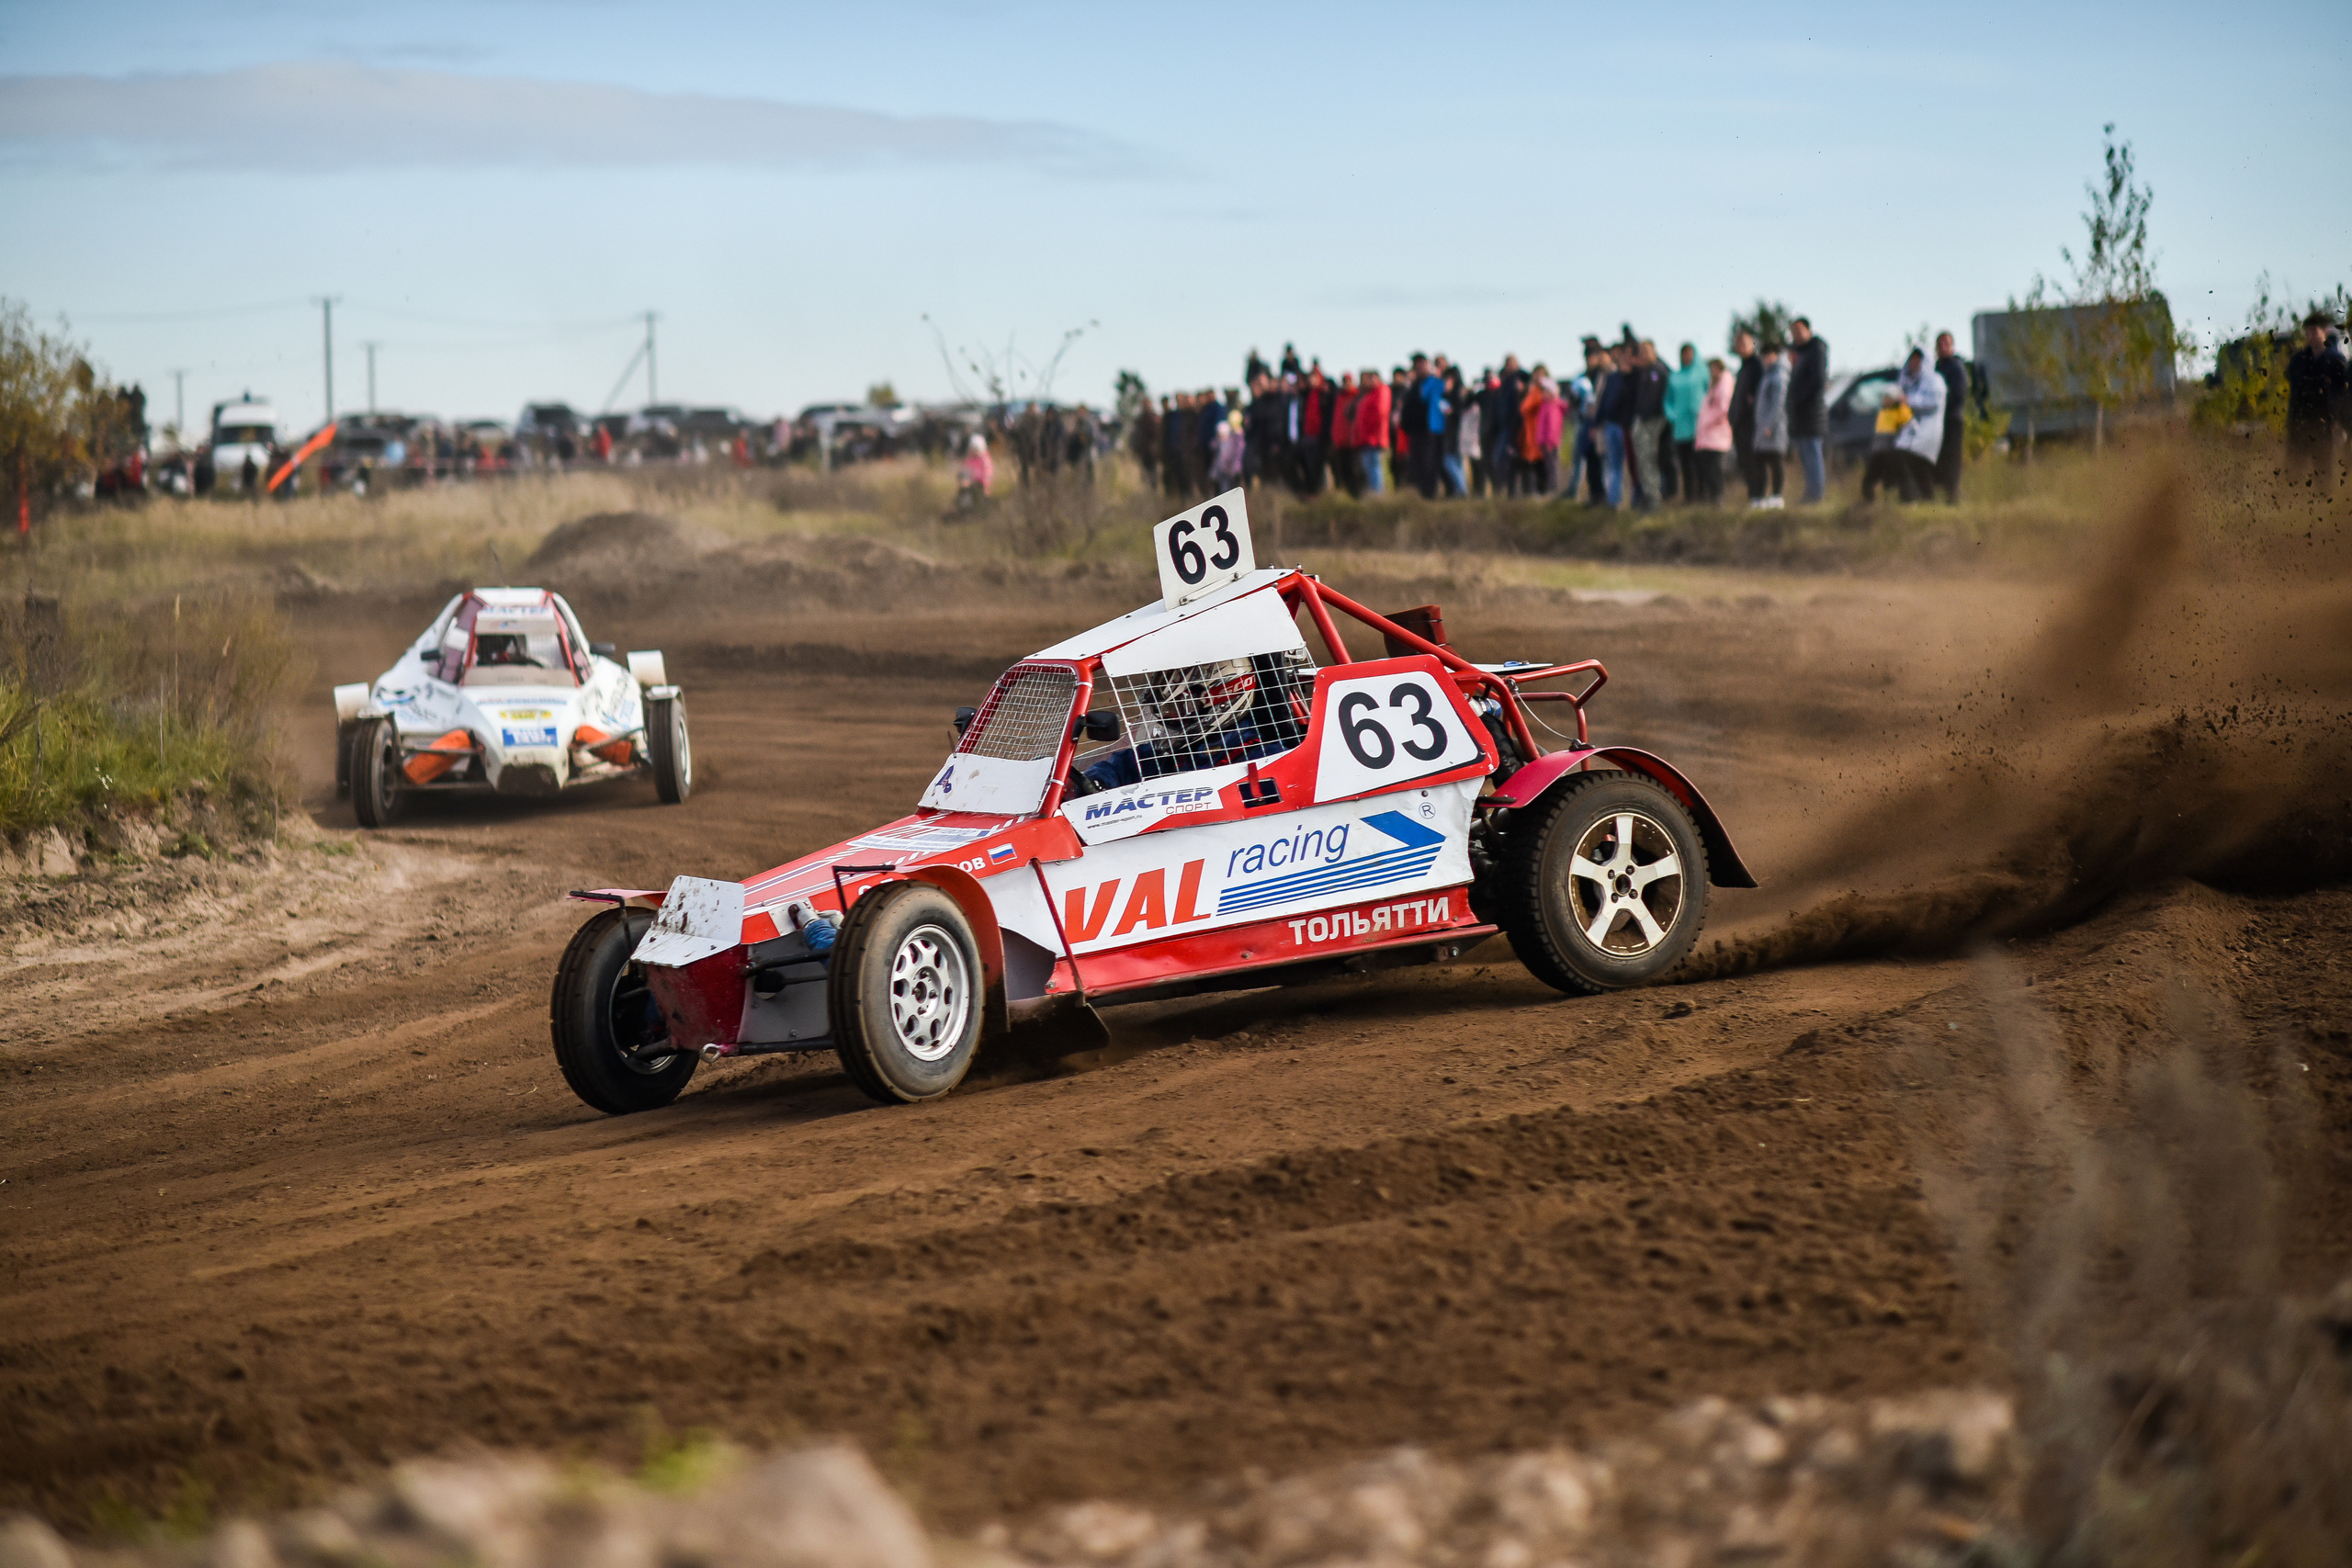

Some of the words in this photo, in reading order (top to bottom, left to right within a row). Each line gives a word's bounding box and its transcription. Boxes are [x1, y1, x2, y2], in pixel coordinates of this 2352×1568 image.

[1169, 505, 1239, 584] 63
[1339, 682, 1448, 769] 63
[1084, 786, 1214, 821] МАСТЕР
[1166, 802, 1212, 815] СПОРТ
[1227, 823, 1351, 878] racing
[1065, 858, 1212, 944] VAL
[1288, 897, 1450, 945] ТОЛЬЯТТИ
